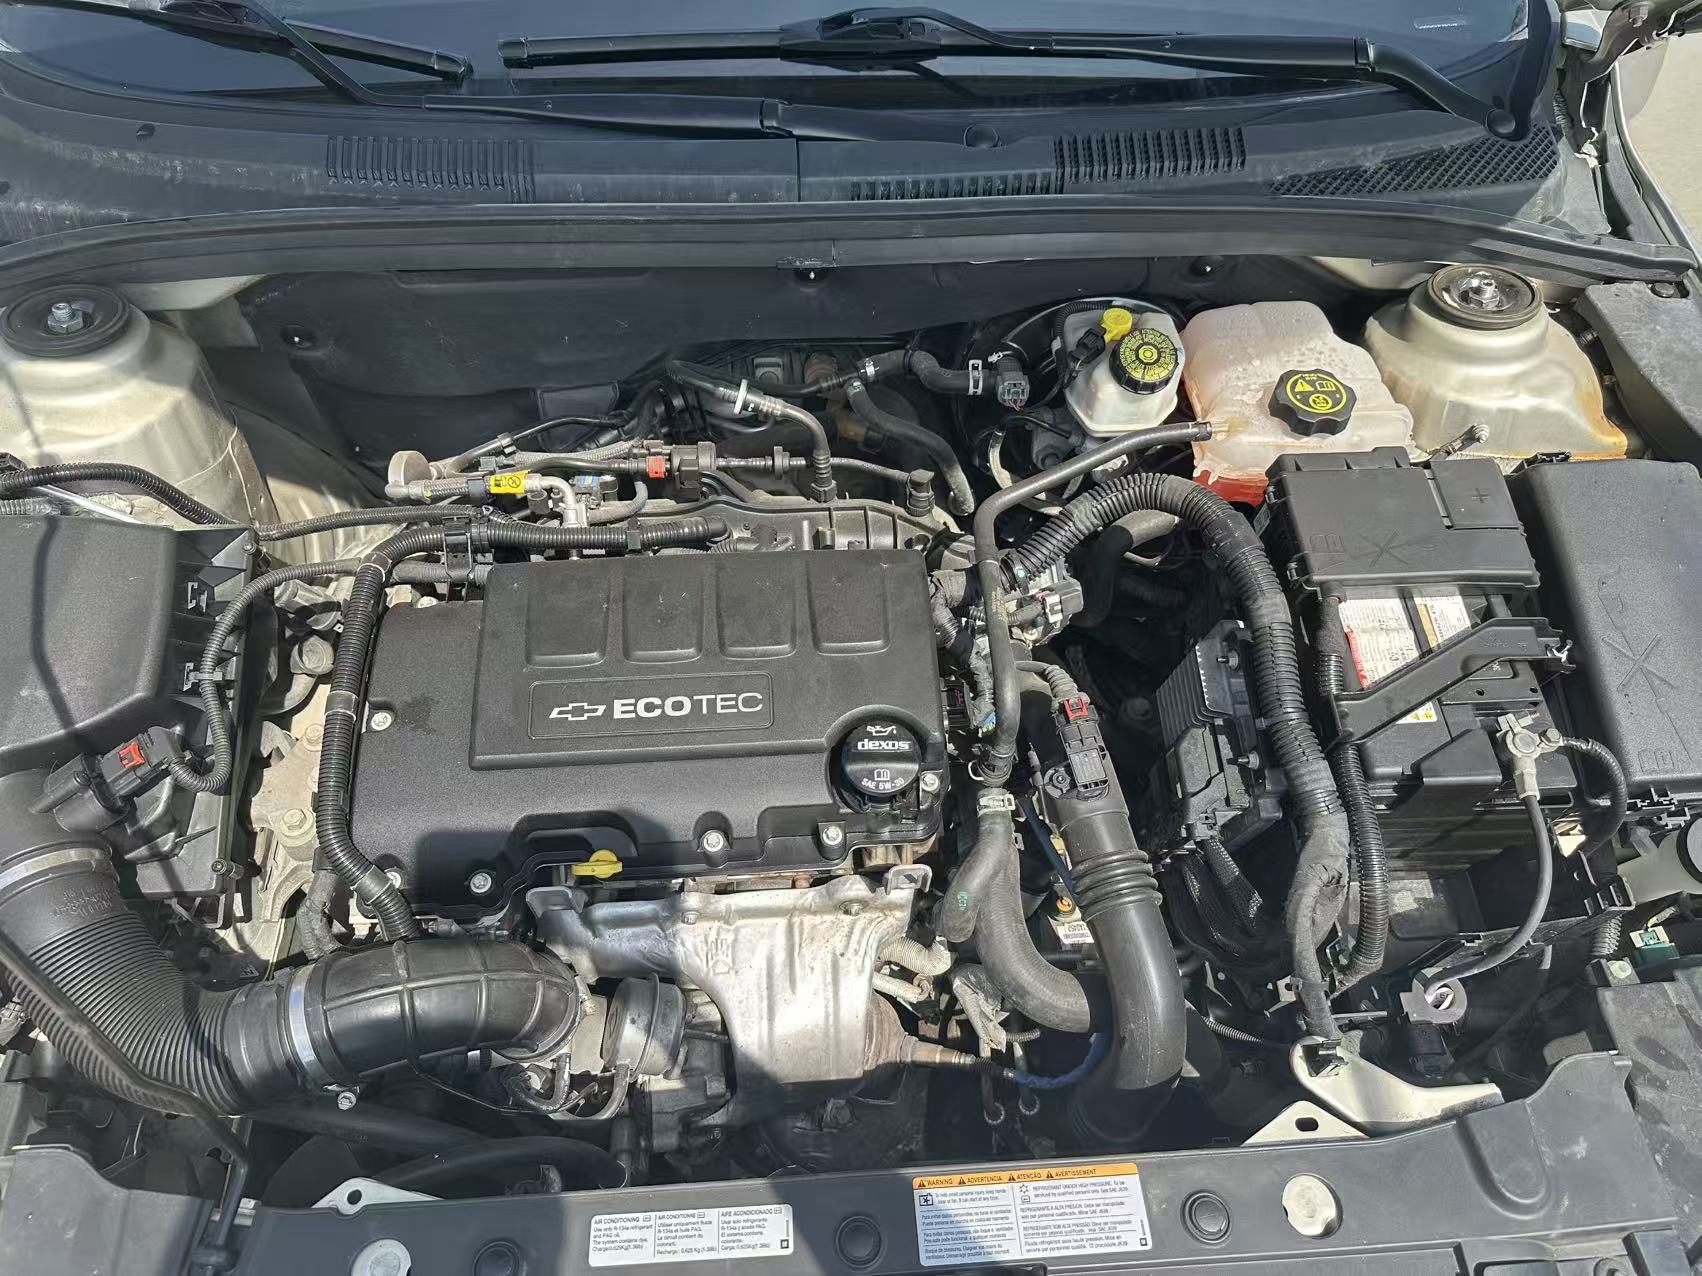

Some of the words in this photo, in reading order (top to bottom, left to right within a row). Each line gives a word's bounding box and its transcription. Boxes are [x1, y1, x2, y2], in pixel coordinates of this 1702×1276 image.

[613, 692, 763, 719] ECOTEC
[857, 738, 911, 750] dexos
[861, 778, 877, 789] SAE
[879, 777, 904, 790] 5W-30
[928, 1178, 953, 1186] WARNING
[967, 1175, 1002, 1184] ADVERTENCIA
[1017, 1172, 1041, 1180] ATENÇÃO
[1055, 1168, 1096, 1177] AVERTISSEMENT
[733, 1208, 773, 1216] ACONDICIONADO
[604, 1216, 640, 1224] CONDITIONING
